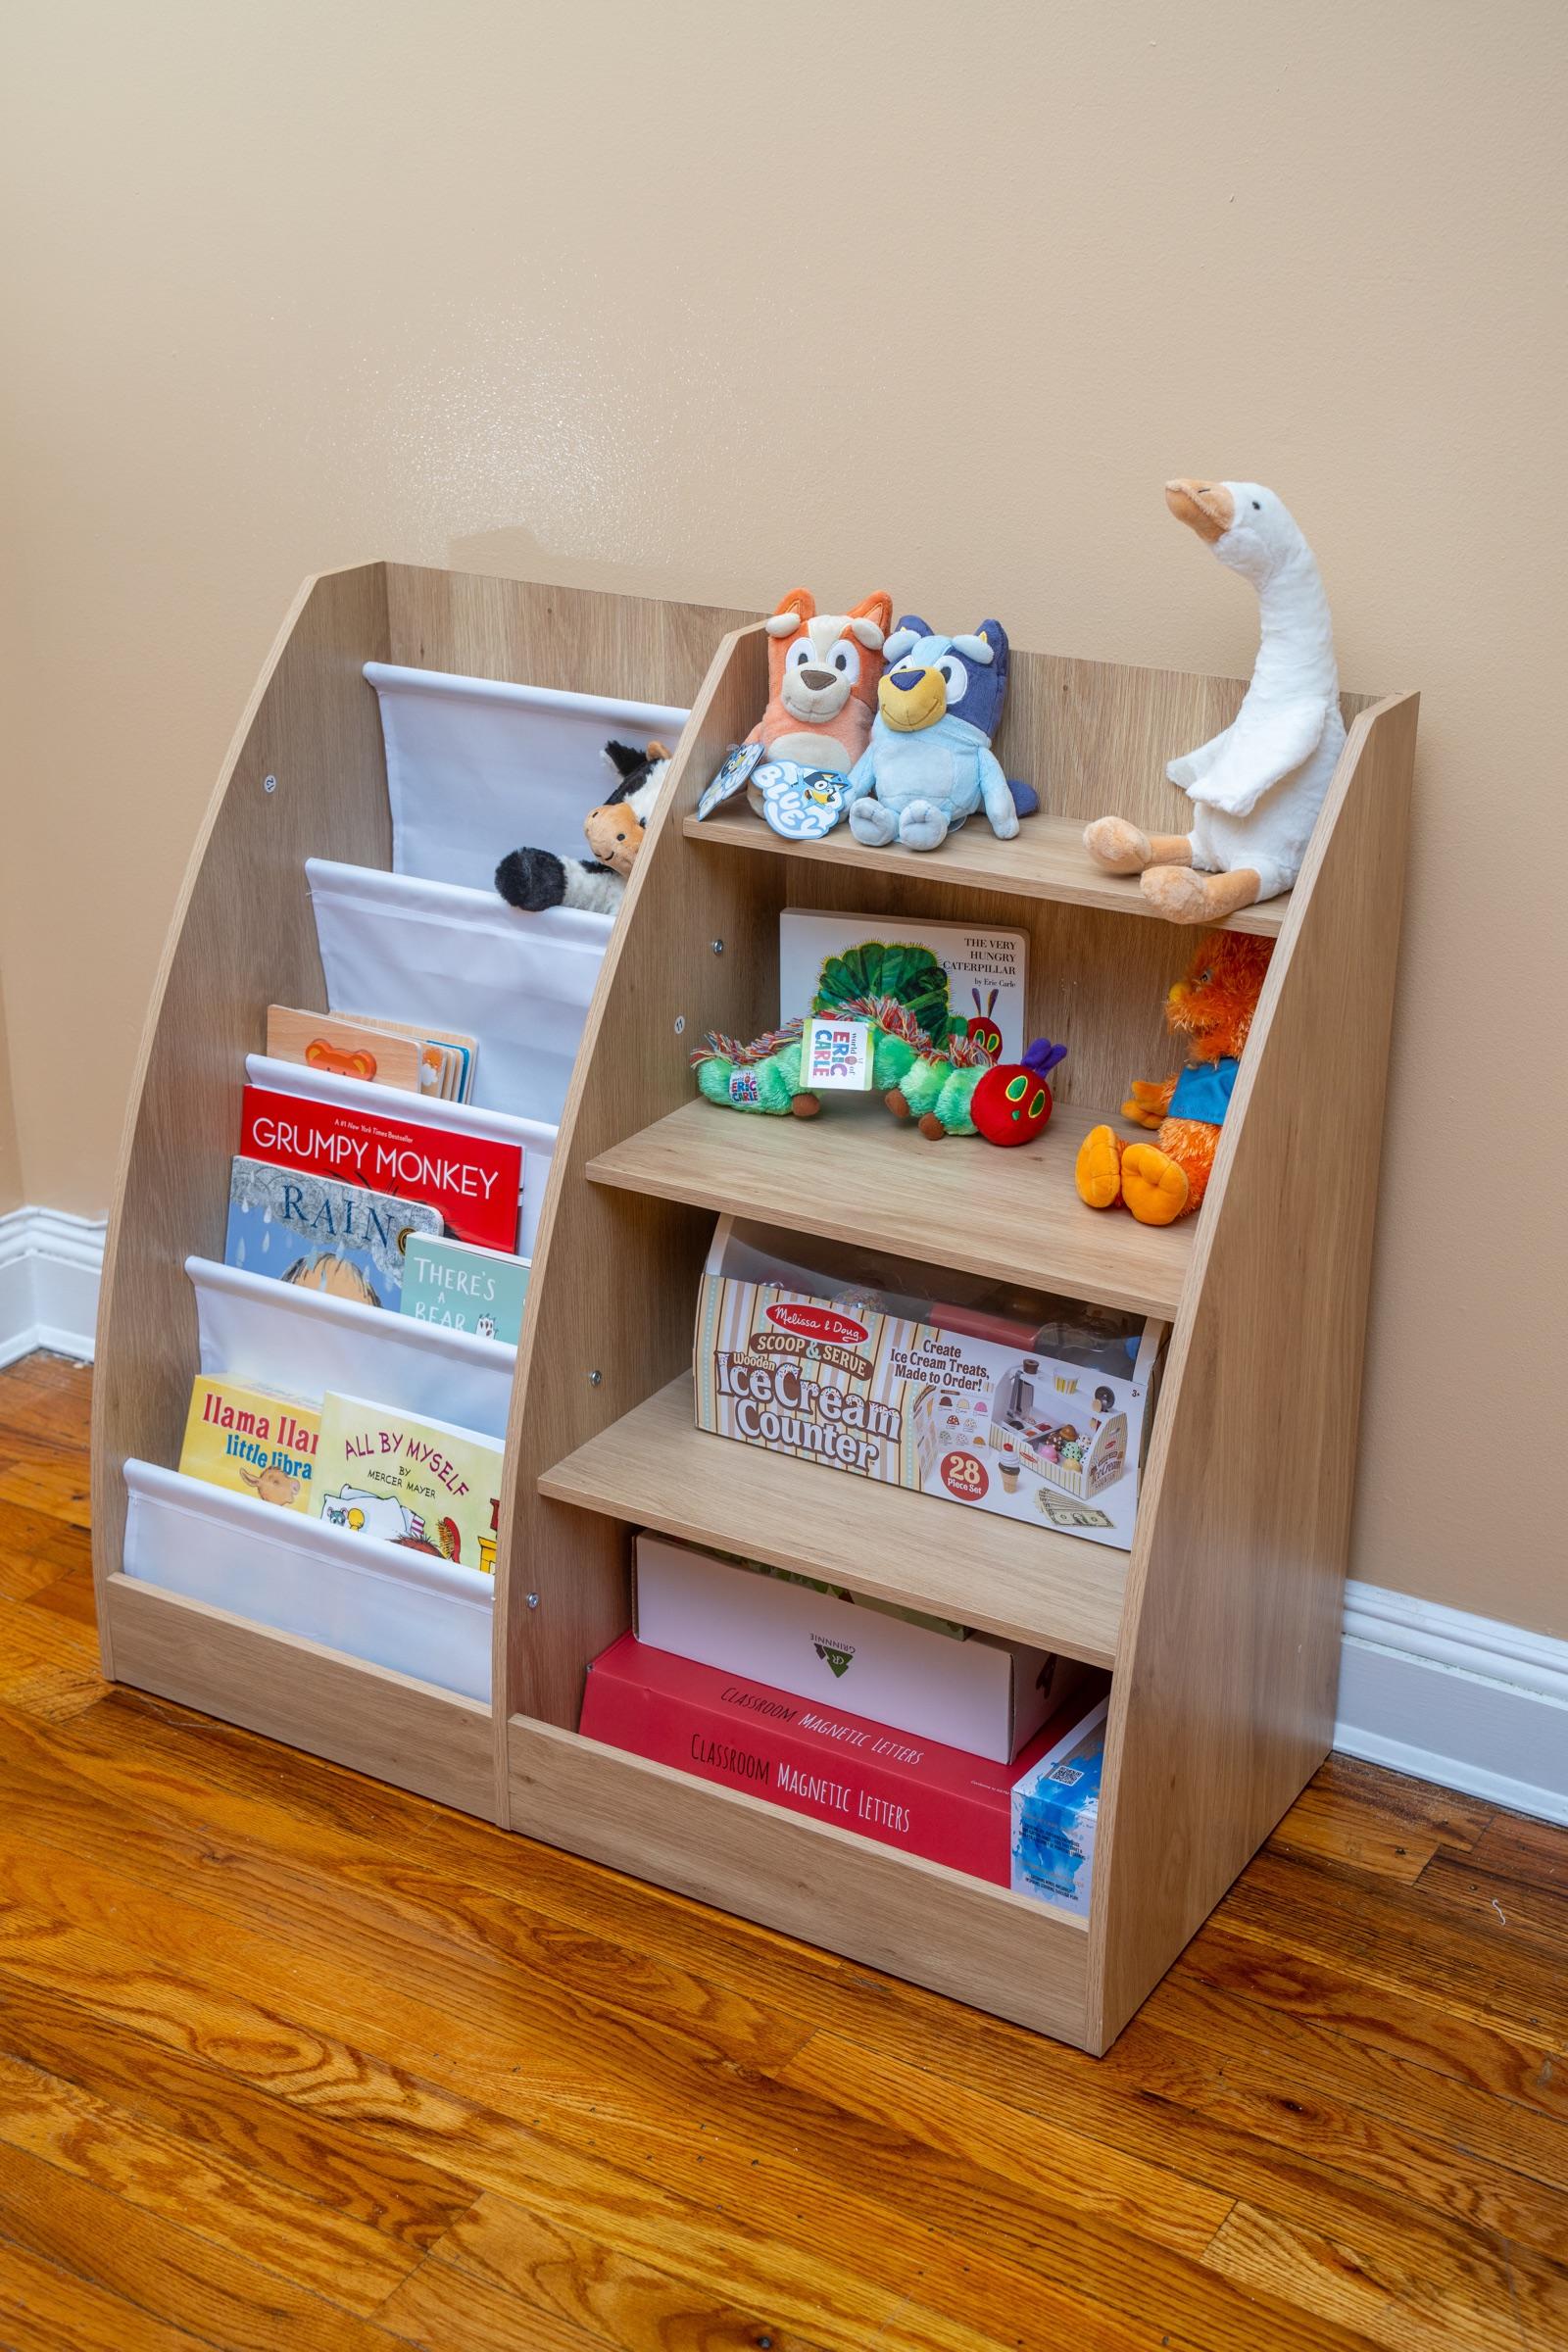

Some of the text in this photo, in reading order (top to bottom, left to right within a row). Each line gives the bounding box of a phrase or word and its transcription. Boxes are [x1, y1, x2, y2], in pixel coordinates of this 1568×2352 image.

[753, 764, 825, 837] BLUEY
[964, 938, 1016, 951] THE VERY
[970, 951, 1016, 962] HUNGRY
[943, 961, 1016, 975] CATERPILLAR
[975, 978, 982, 987] by
[999, 979, 1016, 988] Carle
[813, 1030, 832, 1076] CARLE
[830, 1032, 850, 1077] ERIC
[731, 1080, 757, 1092] ERIC
[732, 1092, 758, 1102] CARLE
[361, 1124, 371, 1134] York
[372, 1127, 388, 1138] Times
[388, 1131, 414, 1144] Bestseller
[252, 1117, 499, 1200] GRUMPY MONKEY
[282, 1184, 395, 1248] RAIN
[414, 1257, 496, 1301] THERE'S
[437, 1292, 446, 1304] A
[415, 1301, 466, 1331] BEAR
[774, 1306, 821, 1330] Melissa
[732, 1351, 776, 1372] Wooden
[756, 1335, 867, 1377] SCOOP & SERVE
[923, 1339, 961, 1358] Create
[890, 1348, 990, 1380] Ice Cream Treats,
[894, 1363, 983, 1392] Made to Order!
[715, 1351, 901, 1441] Ice Cream
[203, 1394, 270, 1440] llama
[737, 1398, 879, 1470] Counter
[226, 1434, 269, 1468] little
[345, 1432, 470, 1496] ALL BY MYSELF
[368, 1469, 436, 1499] MERCER MAYER
[399, 1466, 412, 1477] BY
[949, 1455, 980, 1485] 28
[948, 1478, 982, 1494] Piece Set
[809, 1633, 856, 1654] GRINNNIE
[720, 1687, 925, 1765] CLASSROOM MAGNETIC LETTERS
[691, 1734, 910, 1833] CLASSROOM MAGNETIC LETTERS
